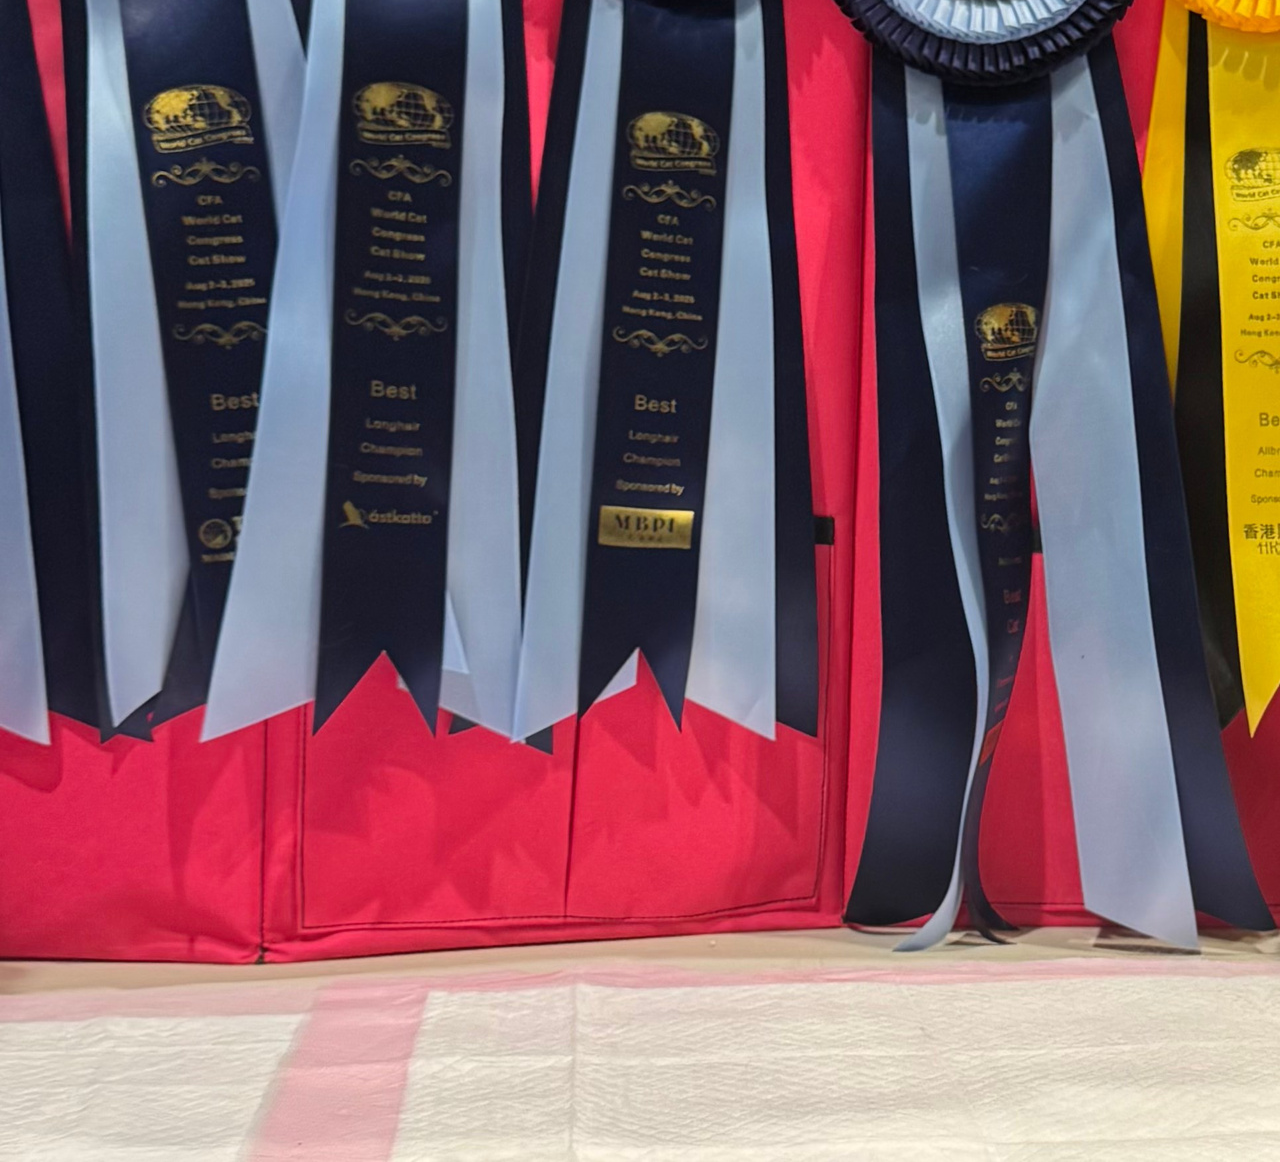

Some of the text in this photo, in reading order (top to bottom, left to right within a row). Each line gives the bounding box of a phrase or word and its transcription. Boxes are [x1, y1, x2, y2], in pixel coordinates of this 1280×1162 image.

[197, 194, 223, 205] CFA
[387, 190, 412, 203] CFA
[1235, 190, 1256, 199] World
[188, 254, 211, 266] Cat
[1249, 257, 1279, 267] World
[1252, 291, 1270, 300] Cat
[1248, 313, 1265, 323] Aug
[1240, 328, 1262, 338] Hong
[370, 380, 418, 400] Best
[210, 391, 259, 411] Best
[634, 394, 678, 414] Best
[413, 474, 428, 488] by
[671, 482, 685, 497] by
